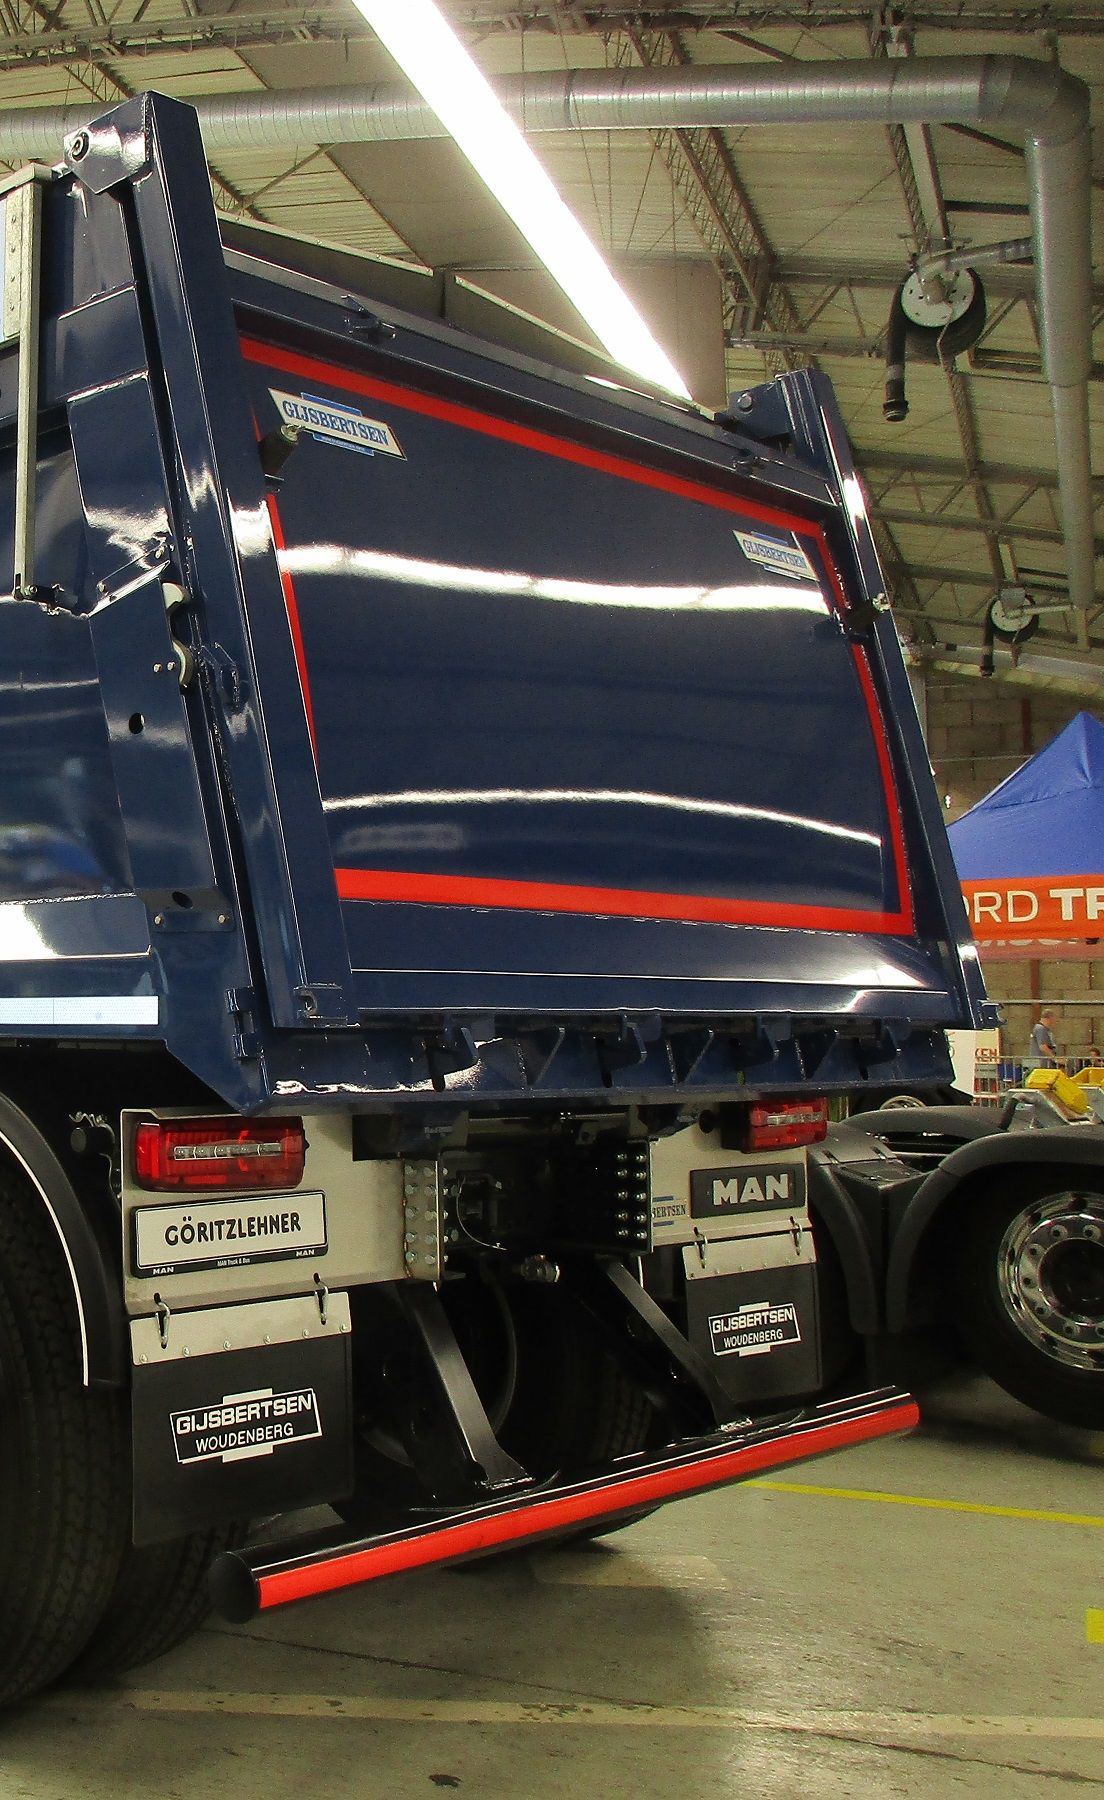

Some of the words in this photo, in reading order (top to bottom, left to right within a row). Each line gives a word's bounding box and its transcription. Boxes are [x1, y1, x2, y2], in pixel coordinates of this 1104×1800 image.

[282, 400, 389, 446] GIJSBERTSEN
[712, 1173, 789, 1206] MAN
[164, 1212, 302, 1246] GÖRITZLEHNER
[295, 1249, 315, 1257] MAN
[152, 1266, 175, 1275] MAN
[712, 1307, 793, 1334] GIJSBERTSEN
[723, 1328, 784, 1349] WOUDENBERG
[176, 1393, 312, 1435] GIJSBERTSEN
[195, 1422, 294, 1453] WOUDENBERG
